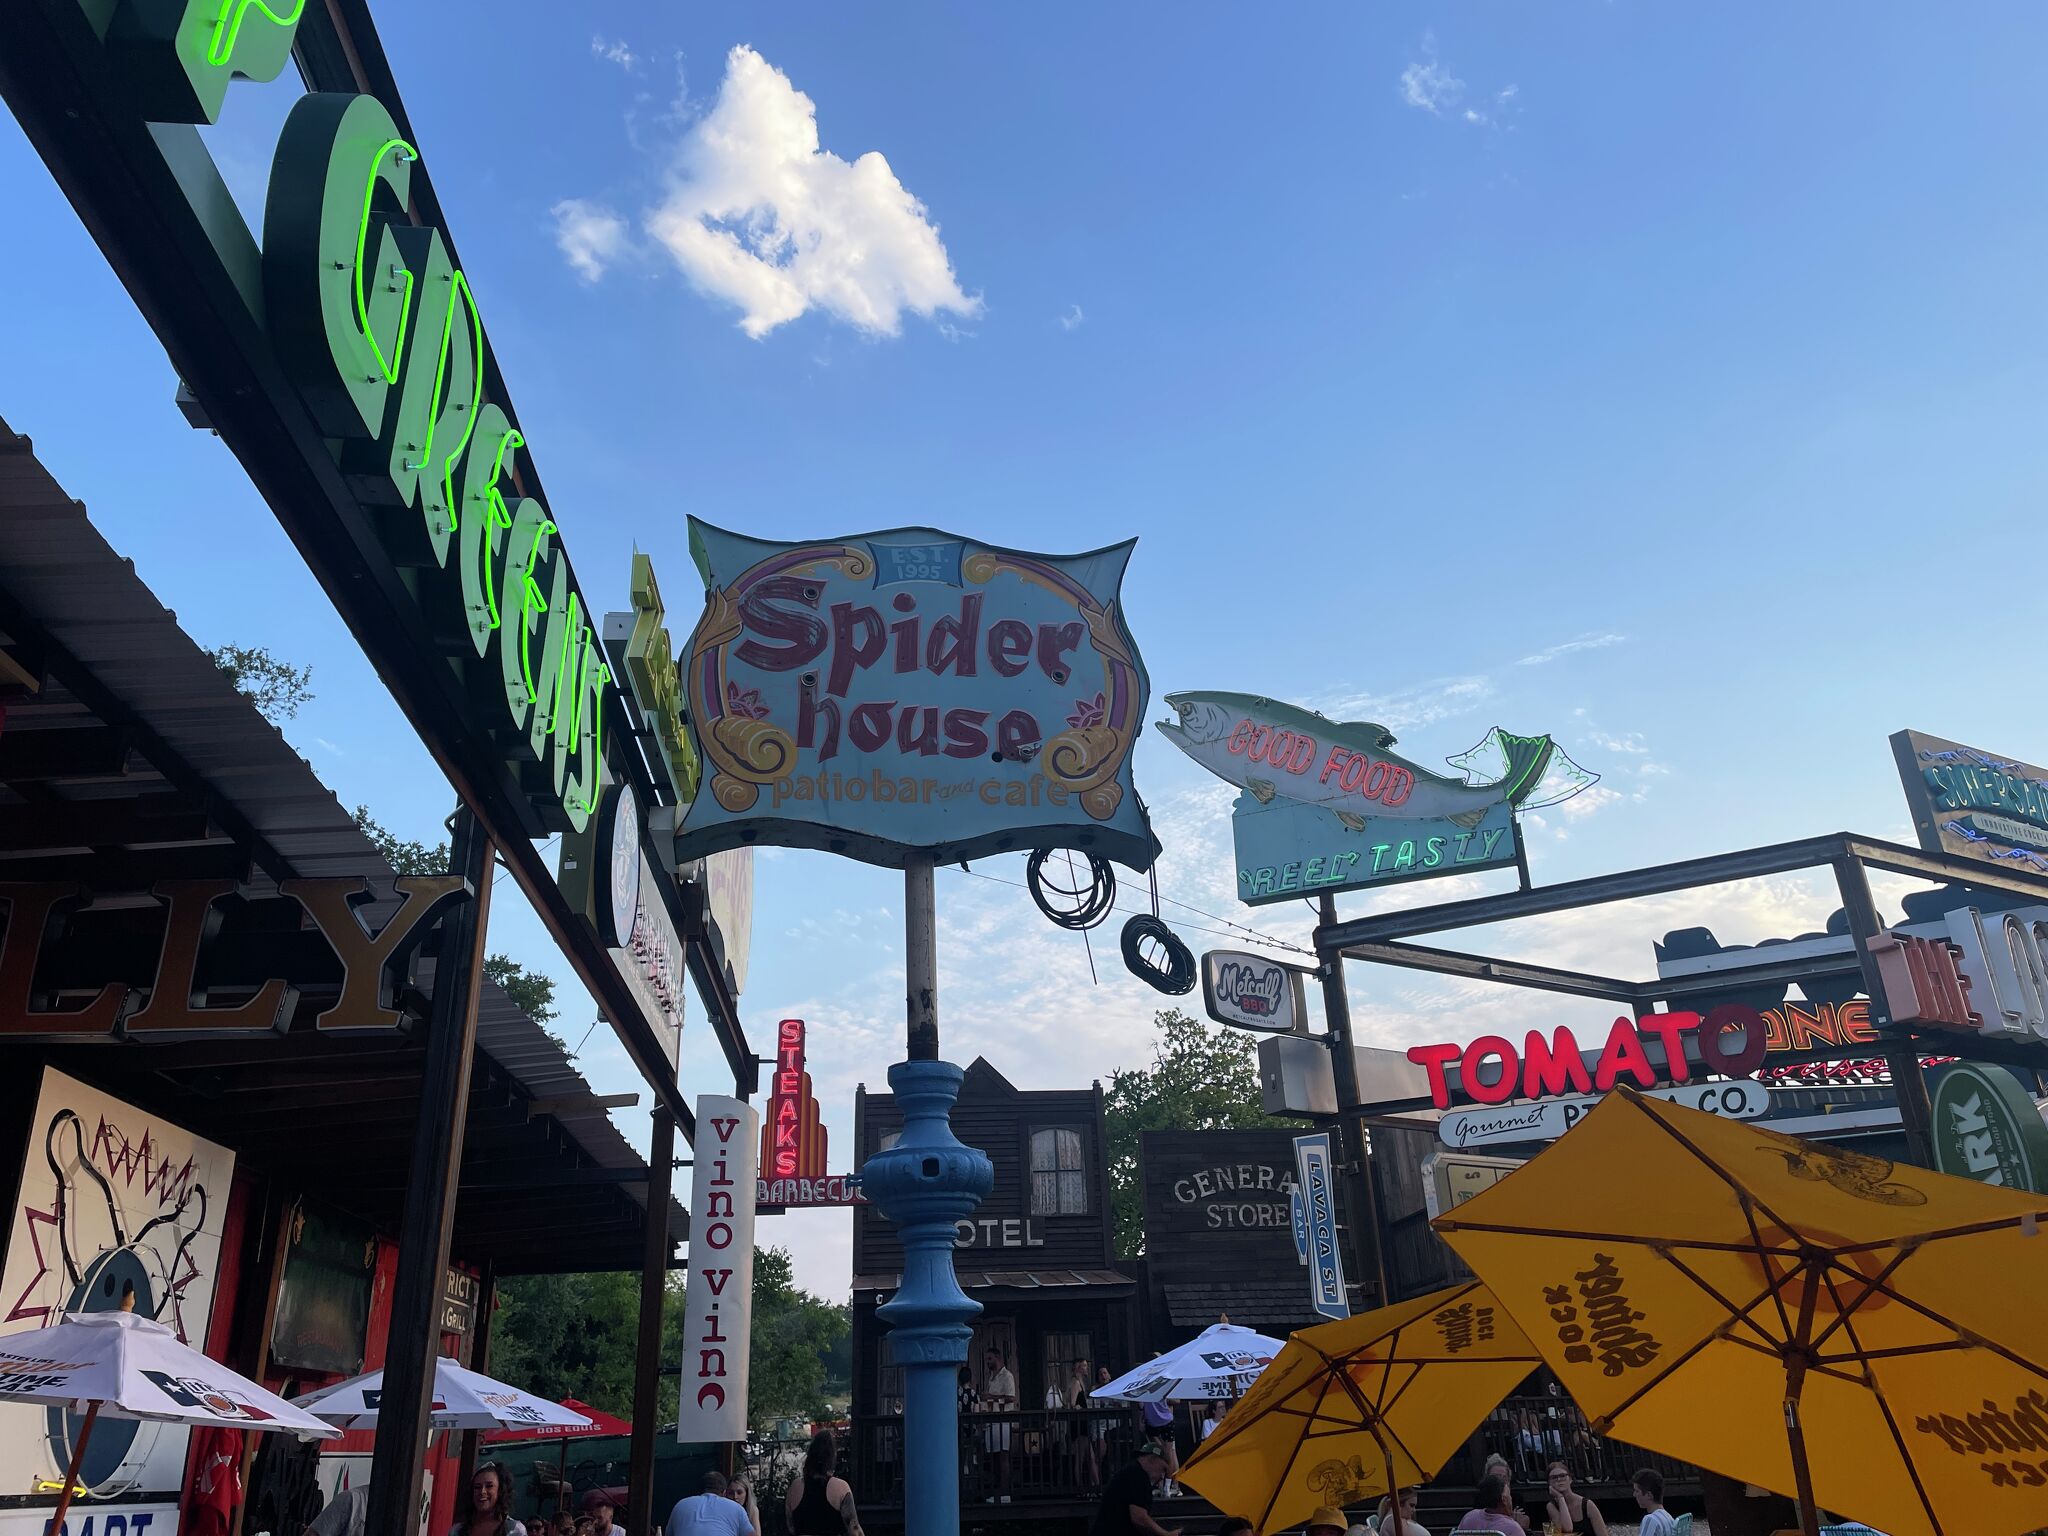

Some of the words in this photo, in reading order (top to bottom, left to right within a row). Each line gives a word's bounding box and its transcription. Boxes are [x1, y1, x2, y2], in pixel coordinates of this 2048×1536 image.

[897, 564, 942, 579] 1995
[733, 575, 1086, 698] Spider
[796, 669, 1043, 768] house
[1227, 718, 1318, 776] GOOD
[1319, 745, 1415, 807] FOOD
[1370, 828, 1508, 876] TASTY
[1242, 997, 1269, 1013] BBQ
[1867, 931, 1985, 1031] THE
[1406, 1004, 1767, 1110] TOMATO
[775, 1021, 801, 1176] STEAKS
[1454, 1103, 1549, 1146] Gourmet
[1698, 1087, 1755, 1114] CO.
[707, 1118, 740, 1250] vino
[1174, 1164, 1296, 1203] GENERA
[953, 1219, 1044, 1248] OTEL
[1206, 1203, 1291, 1229] STORE
[1295, 1208, 1305, 1240] BAR
[1308, 1161, 1332, 1259] LAVACA
[1322, 1267, 1337, 1297] ST
[447, 1269, 472, 1300] RICT
[0, 1351, 31, 1361] ASTES
[536, 1427, 562, 1435] DOS
[565, 1424, 602, 1433] EQUIS
